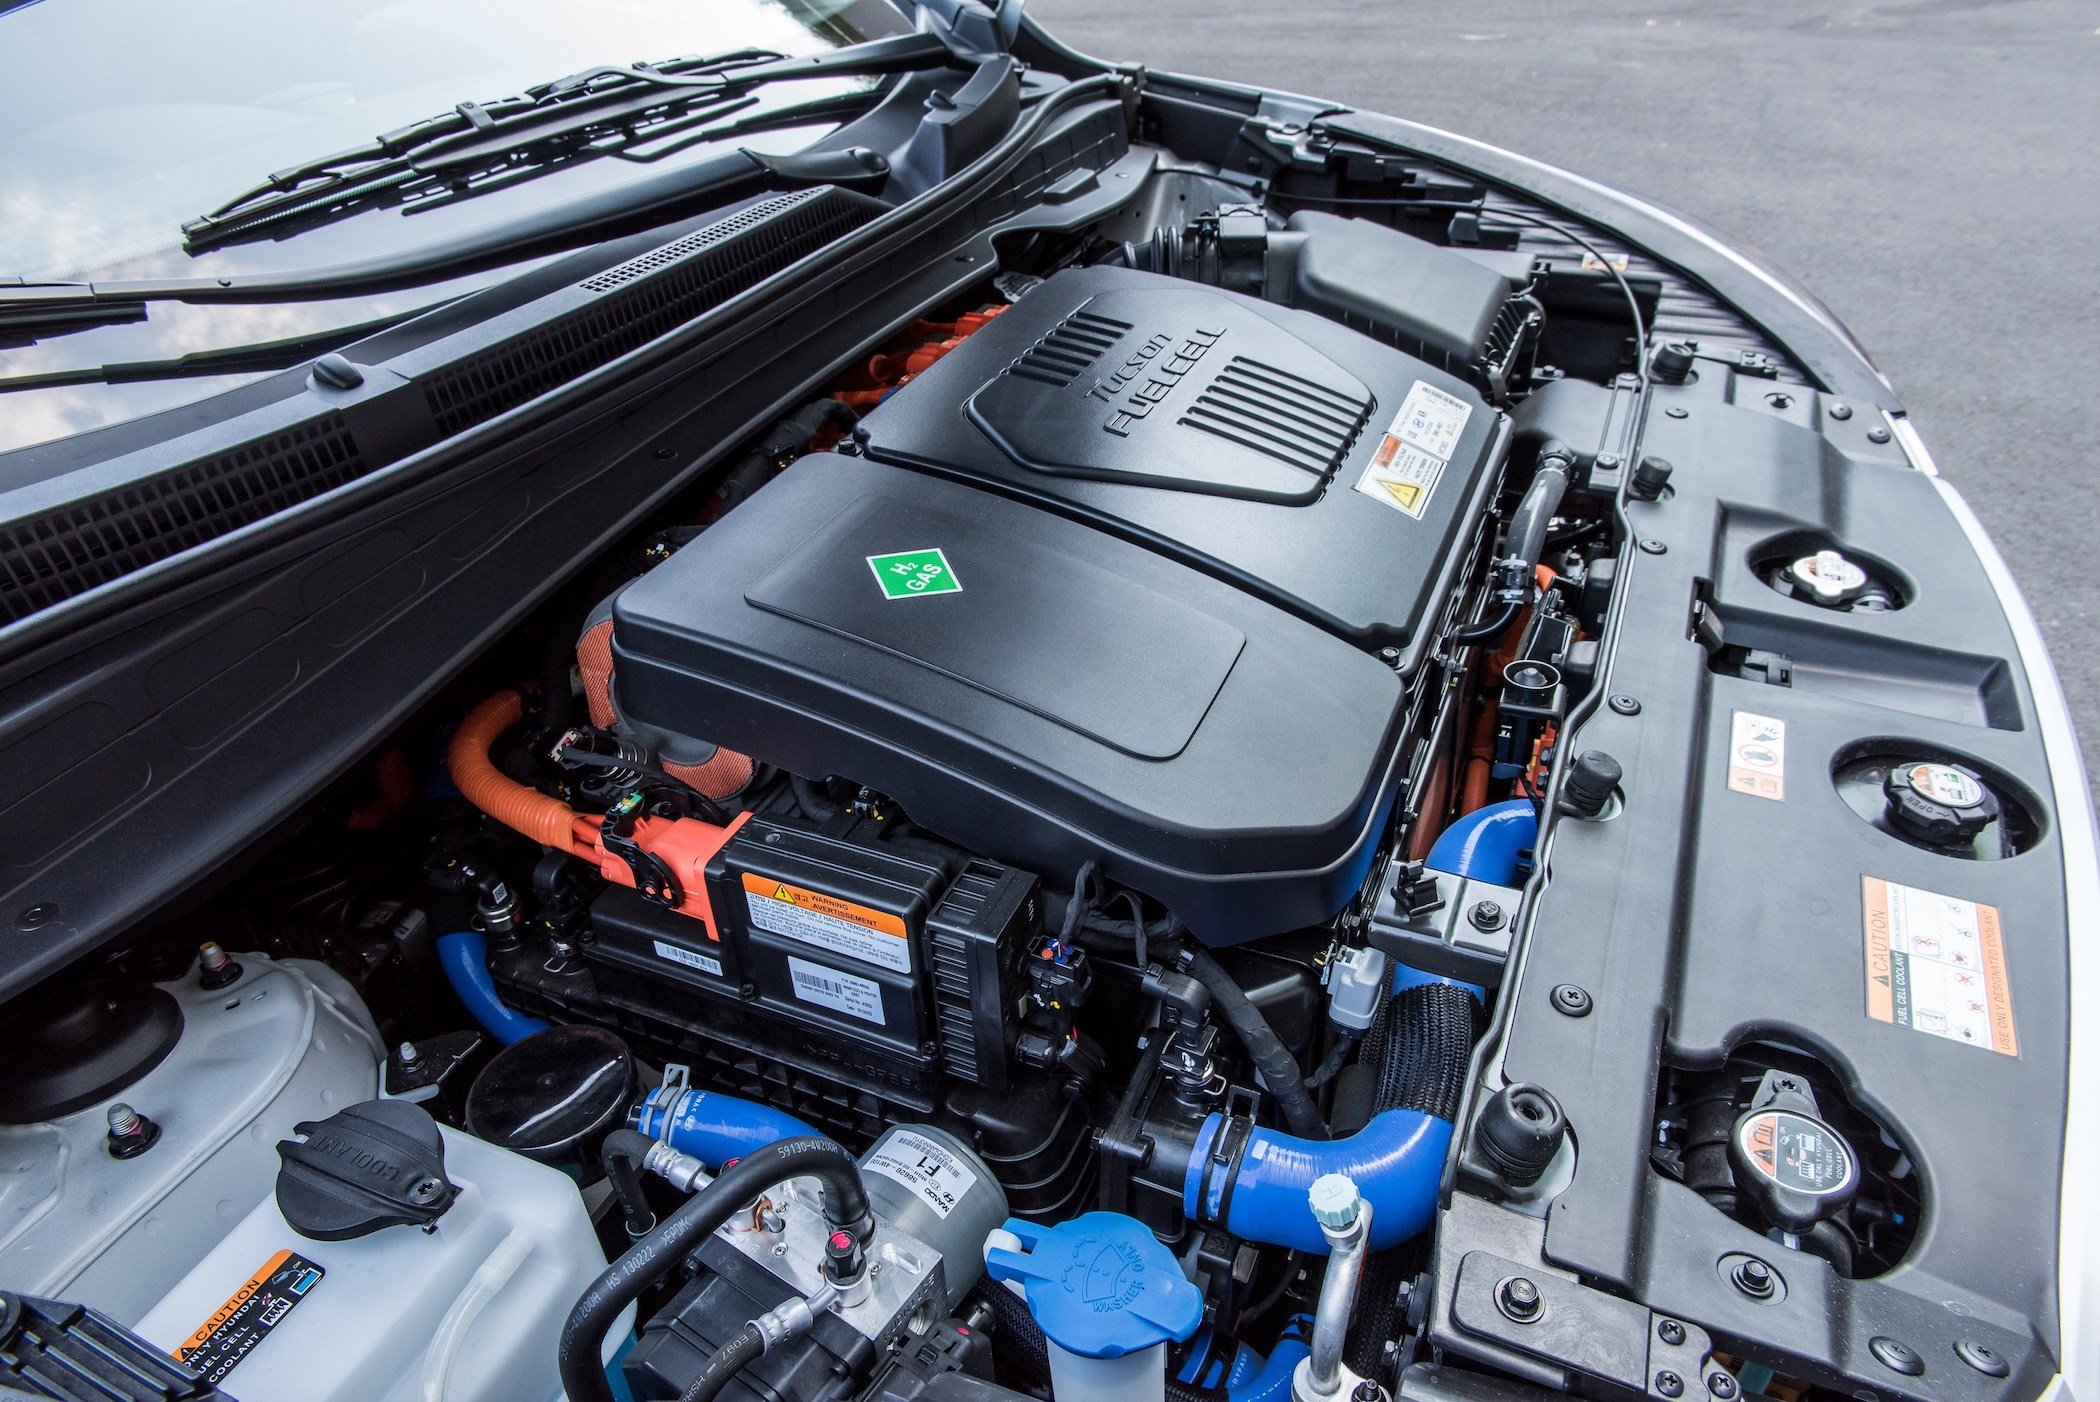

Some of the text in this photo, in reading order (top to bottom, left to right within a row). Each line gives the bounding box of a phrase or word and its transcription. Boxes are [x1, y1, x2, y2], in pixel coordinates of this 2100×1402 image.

[905, 563, 942, 591] GAS
[1905, 795, 1933, 813] OPEN
[772, 900, 787, 909] HIGH
[788, 904, 817, 917] VOLTAGE
[823, 916, 845, 927] HAUTE
[846, 922, 874, 935] TENSION
[810, 894, 849, 911] WARNING
[812, 903, 879, 927] AVERTISSEMENT
[1871, 909, 1889, 972] CAUTION
[1895, 952, 1908, 1025] FUEL CELL COOLANT
[1982, 910, 2011, 1050] USE ONLY DESIGNATED COOLANT
[311, 1135, 401, 1182] COOLANT
[916, 1155, 942, 1178] F1
[1825, 1164, 1833, 1179] FUEL
[924, 1187, 950, 1213] MANDO
[930, 1180, 940, 1190] KIA
[292, 1260, 302, 1270] OK
[605, 1272, 621, 1290] HS
[622, 1245, 656, 1276] 130222
[1117, 1240, 1145, 1272] ONLY
[195, 1279, 260, 1342] CAUTION
[1092, 1280, 1144, 1313] WASHER
[213, 1294, 260, 1340] HYUNDAI
[197, 1325, 250, 1374] UEL CELL
[208, 1332, 260, 1383] COOLANT
